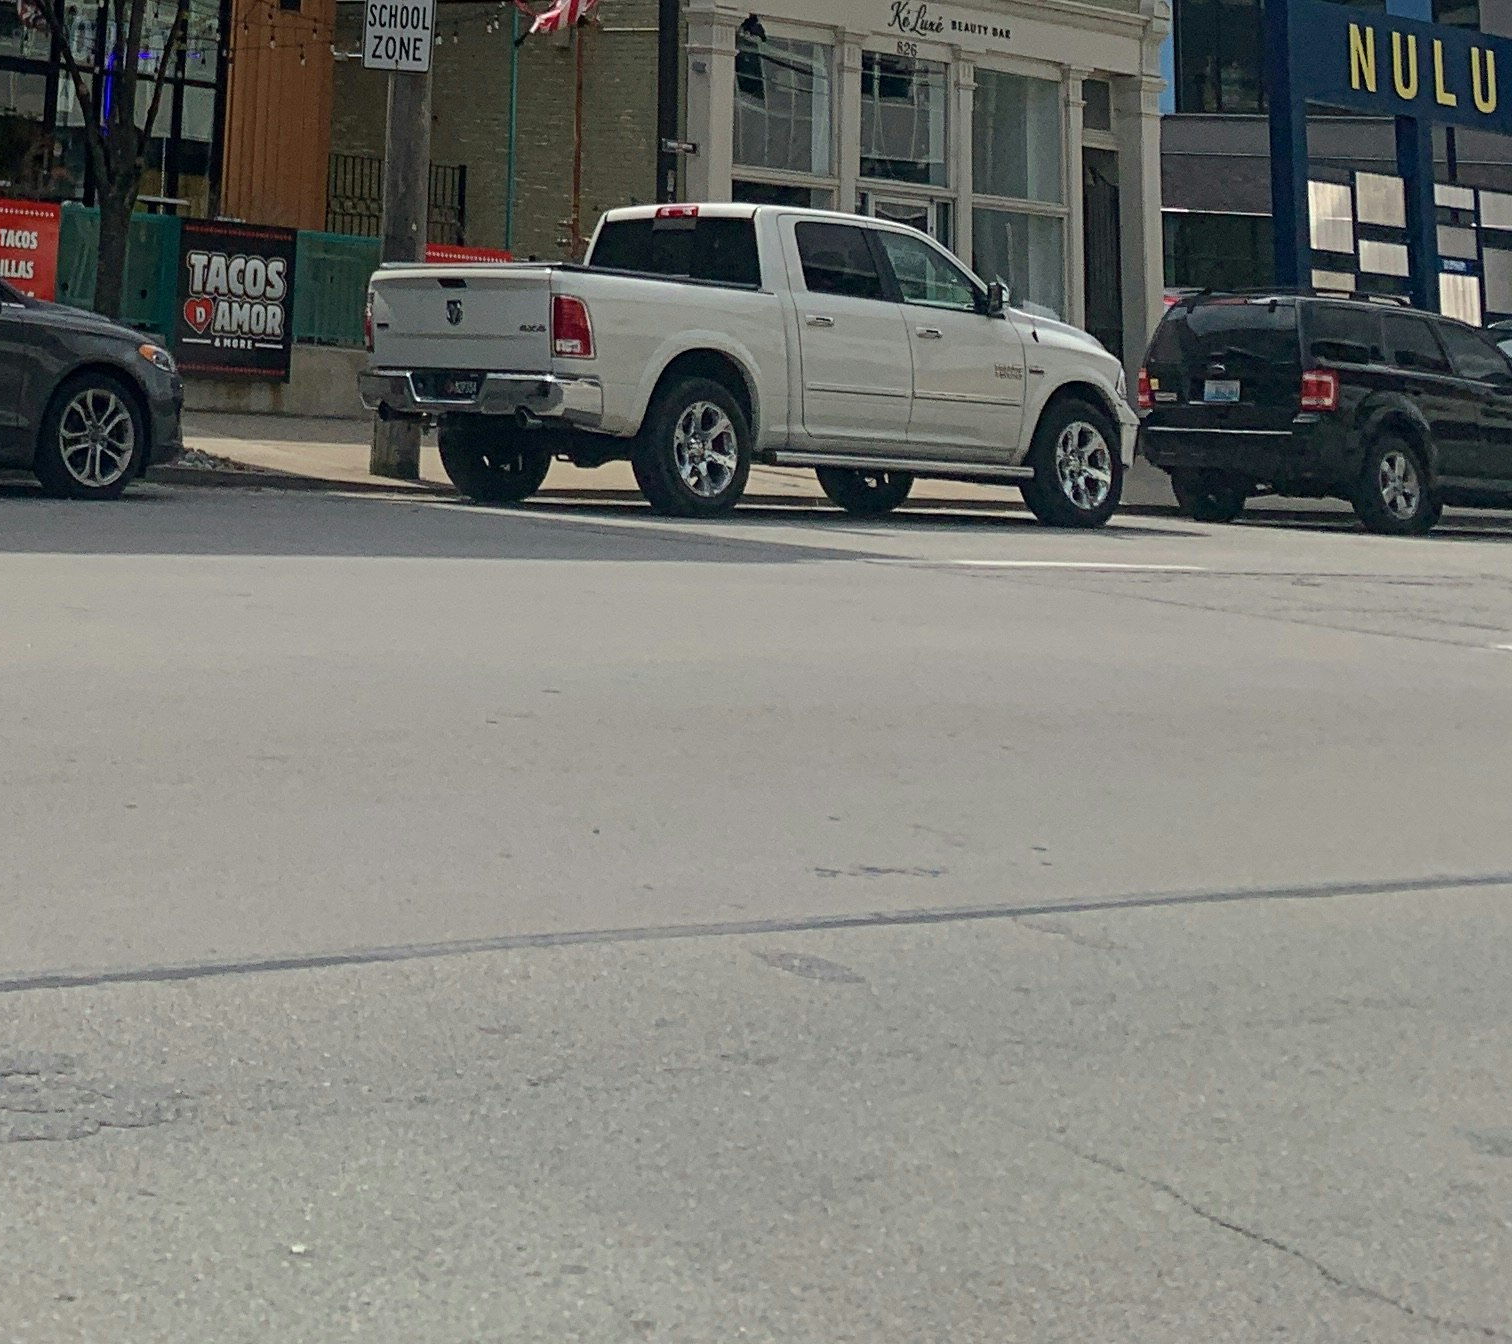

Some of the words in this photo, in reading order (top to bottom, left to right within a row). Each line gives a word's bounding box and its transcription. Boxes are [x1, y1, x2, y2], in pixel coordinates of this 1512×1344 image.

[368, 4, 430, 30] SCHOOL
[951, 20, 988, 36] BEAUTY
[991, 26, 1012, 39] BAR
[371, 35, 423, 62] ZONE
[1348, 23, 1497, 114] NULU
[0, 228, 38, 249] TACOS
[186, 250, 287, 302] TACOS
[195, 307, 206, 323] D
[212, 298, 285, 340] AMOR
[223, 339, 253, 350] MORE
